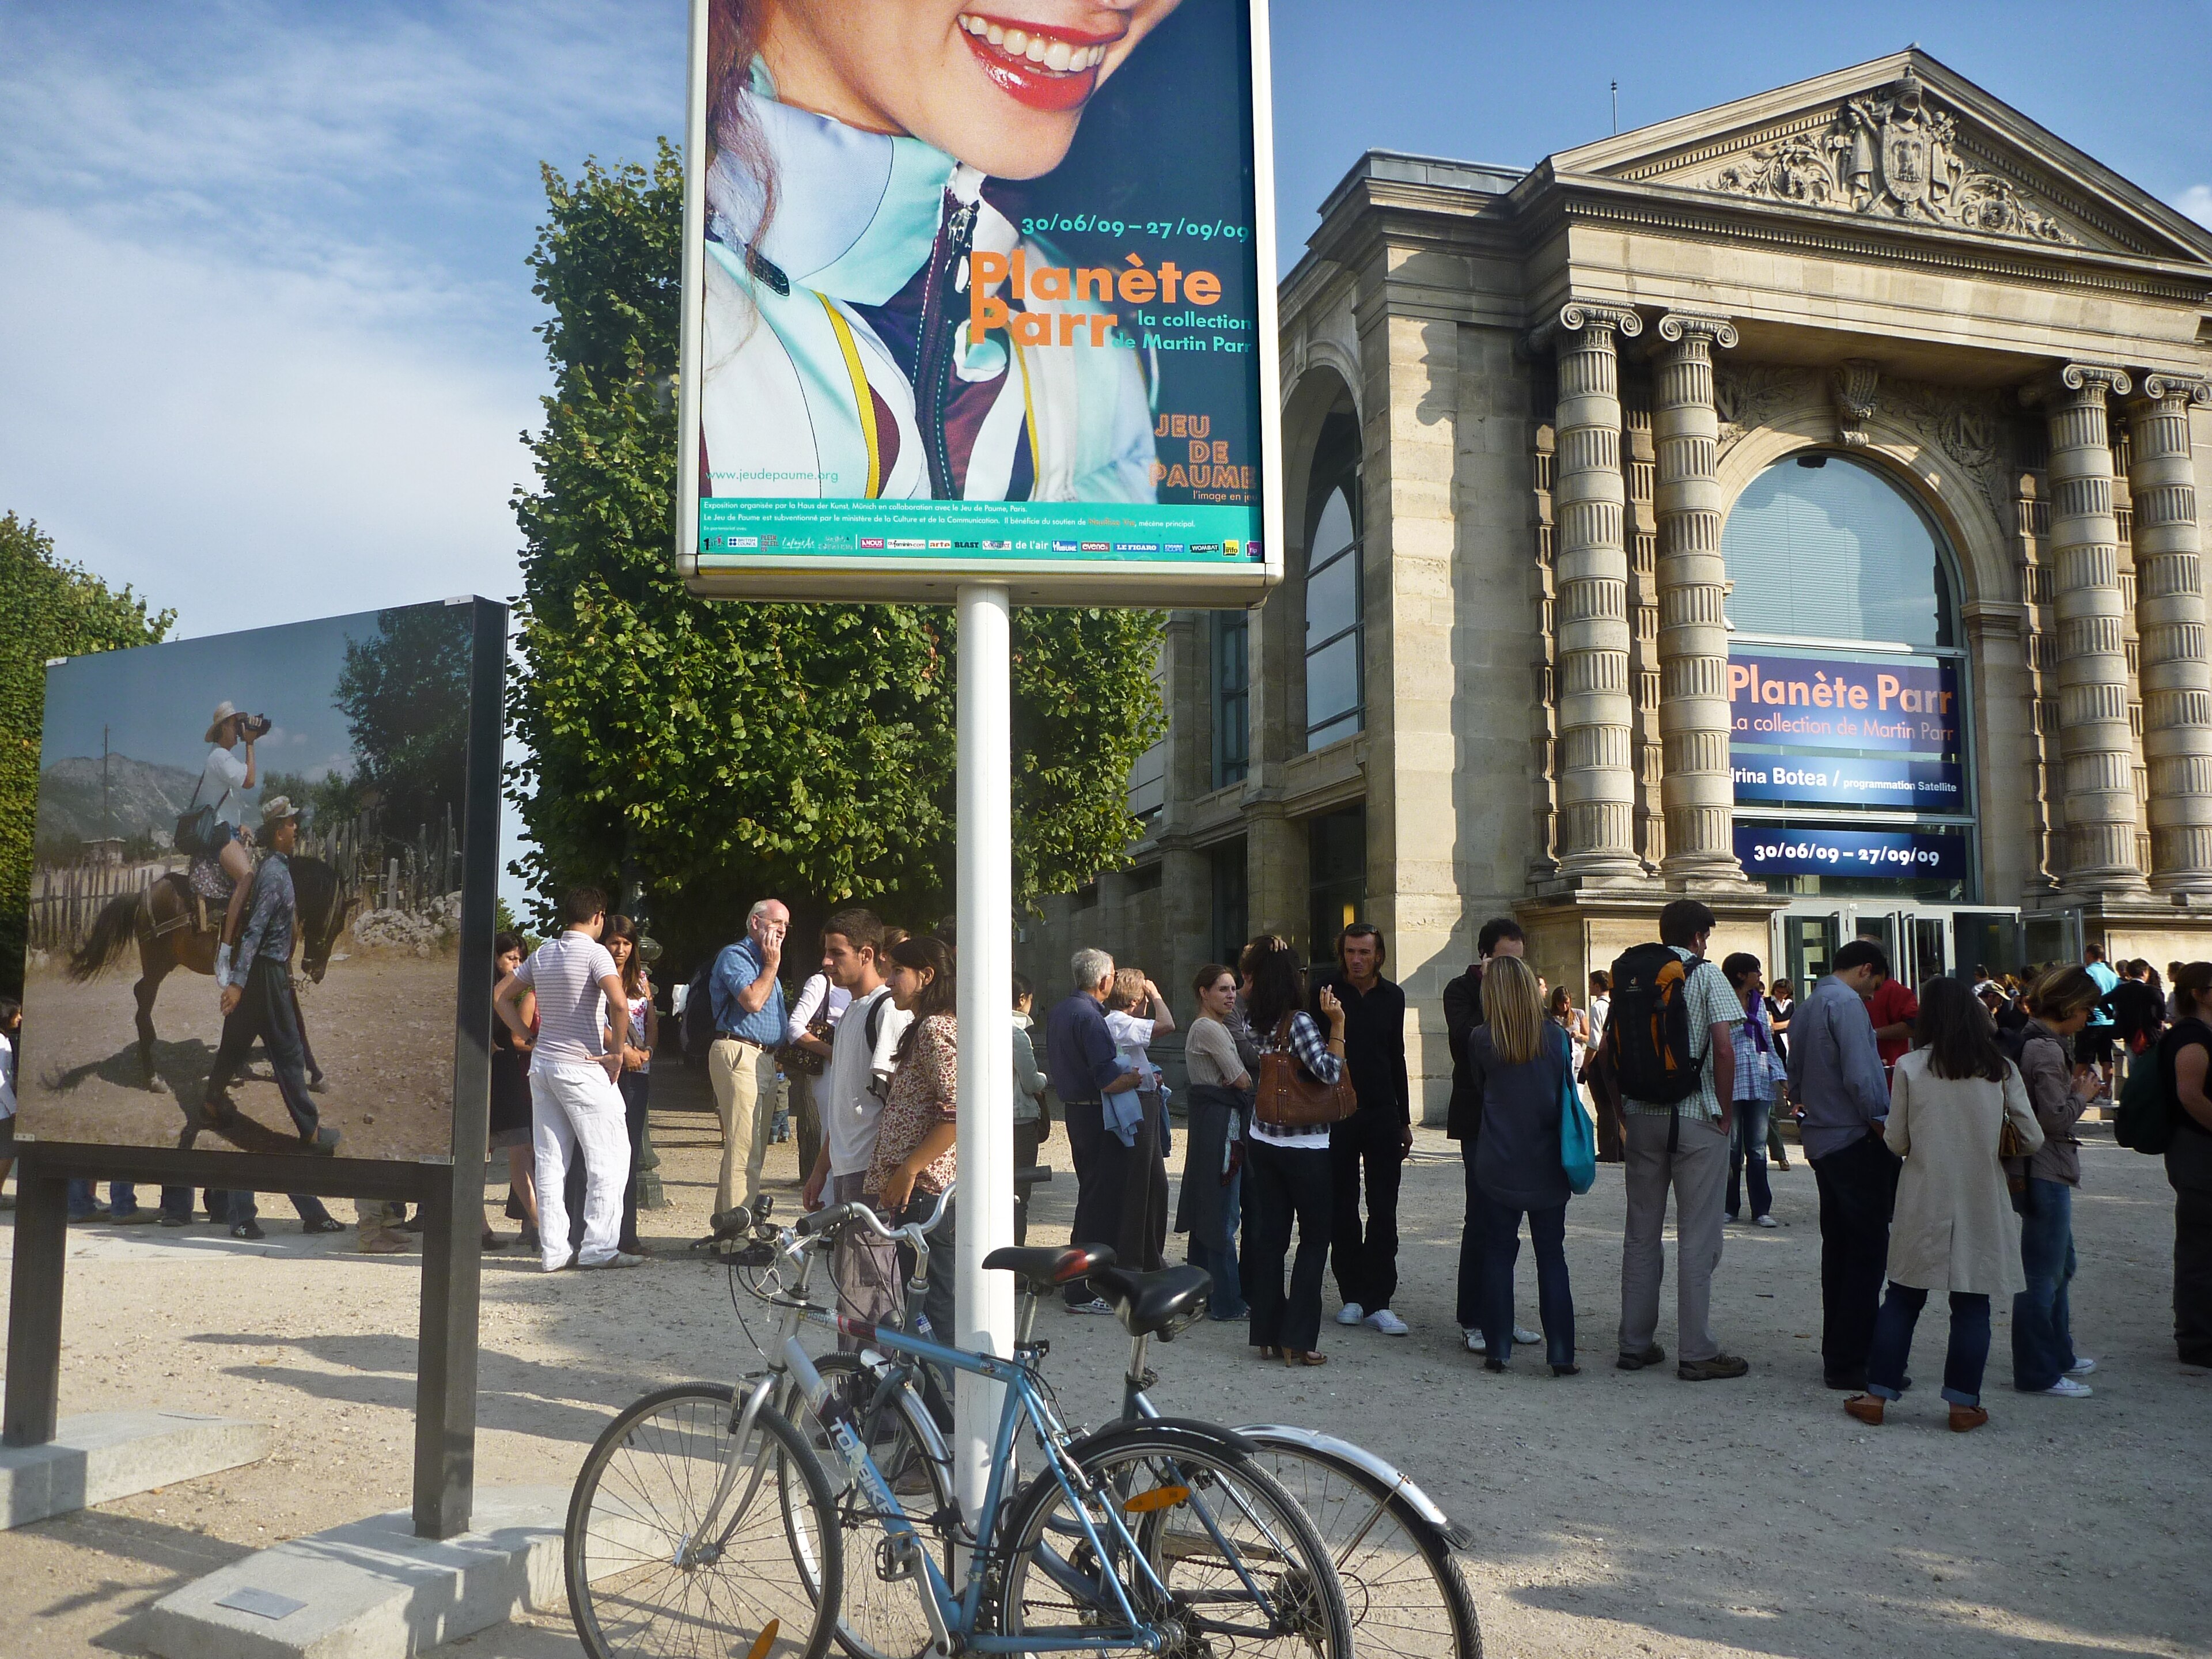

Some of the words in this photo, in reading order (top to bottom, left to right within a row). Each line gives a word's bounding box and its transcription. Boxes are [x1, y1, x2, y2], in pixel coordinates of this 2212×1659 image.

[971, 249, 1221, 305] Planète
[971, 297, 1118, 347] Parr
[1138, 310, 1156, 326] la
[1162, 311, 1251, 330] collection
[1112, 332, 1135, 349] de
[1143, 334, 1206, 351] Martin
[1213, 336, 1251, 353] Parr
[1154, 414, 1210, 438] JEU
[1189, 440, 1229, 464] DE
[706, 468, 839, 483] www.jeudepaume.org
[1149, 463, 1257, 489] PAUME
[984, 505, 1008, 513] Paume,
[1016, 541, 1027, 549] de
[1029, 541, 1048, 550] l'air
[1727, 664, 1869, 710] Planète
[1877, 674, 1952, 714] Parr
[1754, 713, 1831, 734] collection
[1836, 717, 1857, 736] de
[1863, 719, 1915, 739] Martin
[1921, 722, 1954, 741] Parr
[1772, 767, 1827, 786] Botea
[1843, 780, 1915, 790] programmation
[1918, 782, 1957, 792] Satellite
[1753, 842, 1839, 863] 30/06/09
[1858, 846, 1940, 866] 27/09/09
